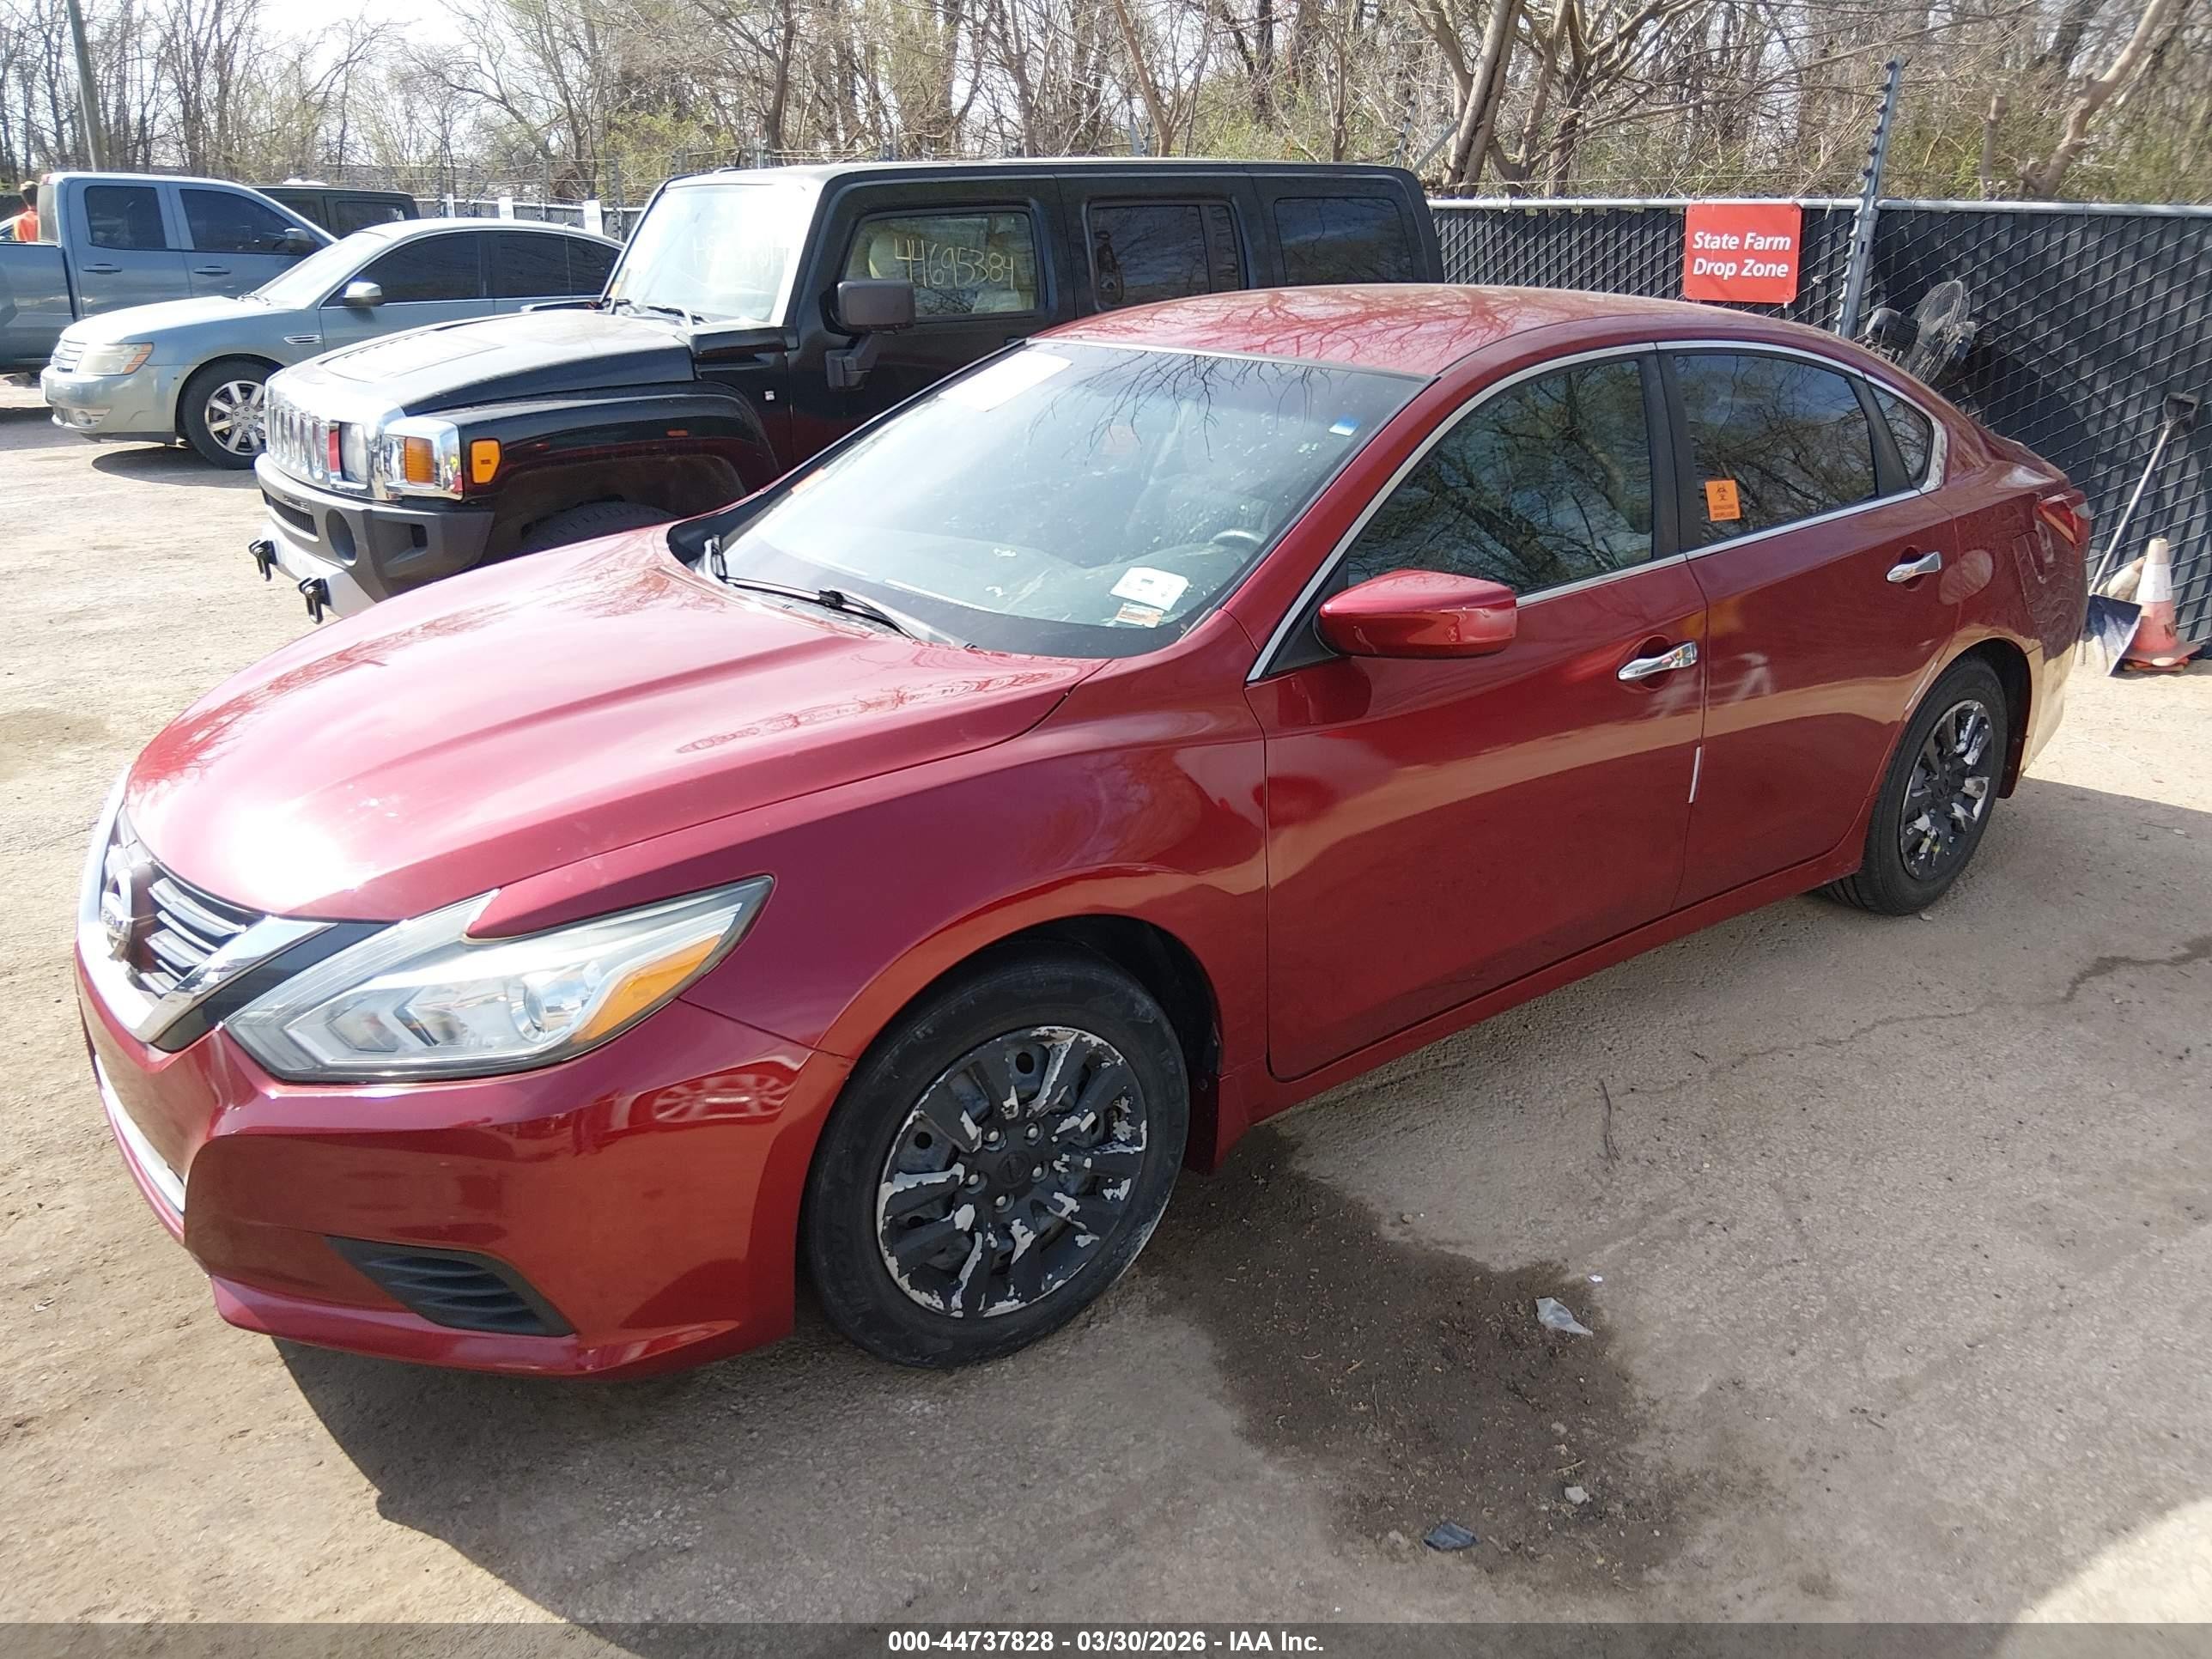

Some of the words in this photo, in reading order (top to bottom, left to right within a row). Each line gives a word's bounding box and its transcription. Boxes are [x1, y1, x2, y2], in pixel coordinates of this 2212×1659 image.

[1692, 231, 1740, 250] State
[1743, 232, 1791, 251] Farm
[895, 239, 1014, 289] 44695384
[1692, 258, 1737, 280] Drop
[1741, 259, 1789, 277] Zone
